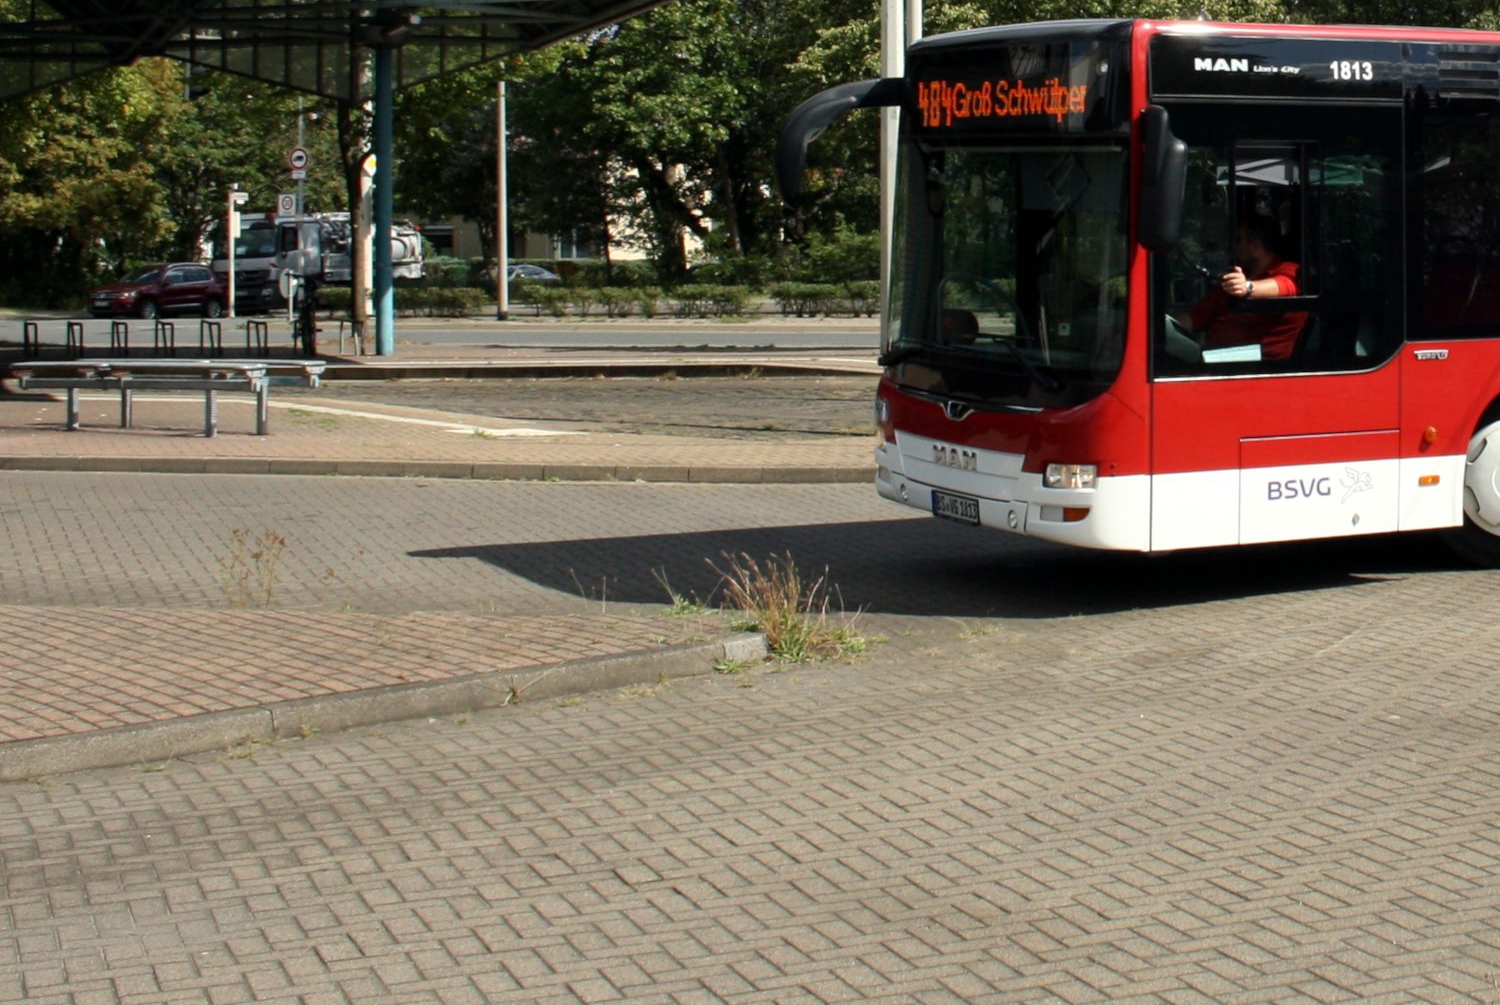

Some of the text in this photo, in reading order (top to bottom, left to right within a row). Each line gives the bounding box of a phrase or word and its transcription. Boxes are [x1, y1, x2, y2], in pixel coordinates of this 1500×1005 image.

[1194, 57, 1300, 75] MAN Lion's City
[1330, 60, 1373, 81] 1813
[918, 77, 1088, 127] 484 Groß Schwülper
[931, 443, 979, 472] MAN
[1267, 477, 1332, 501] BSVG
